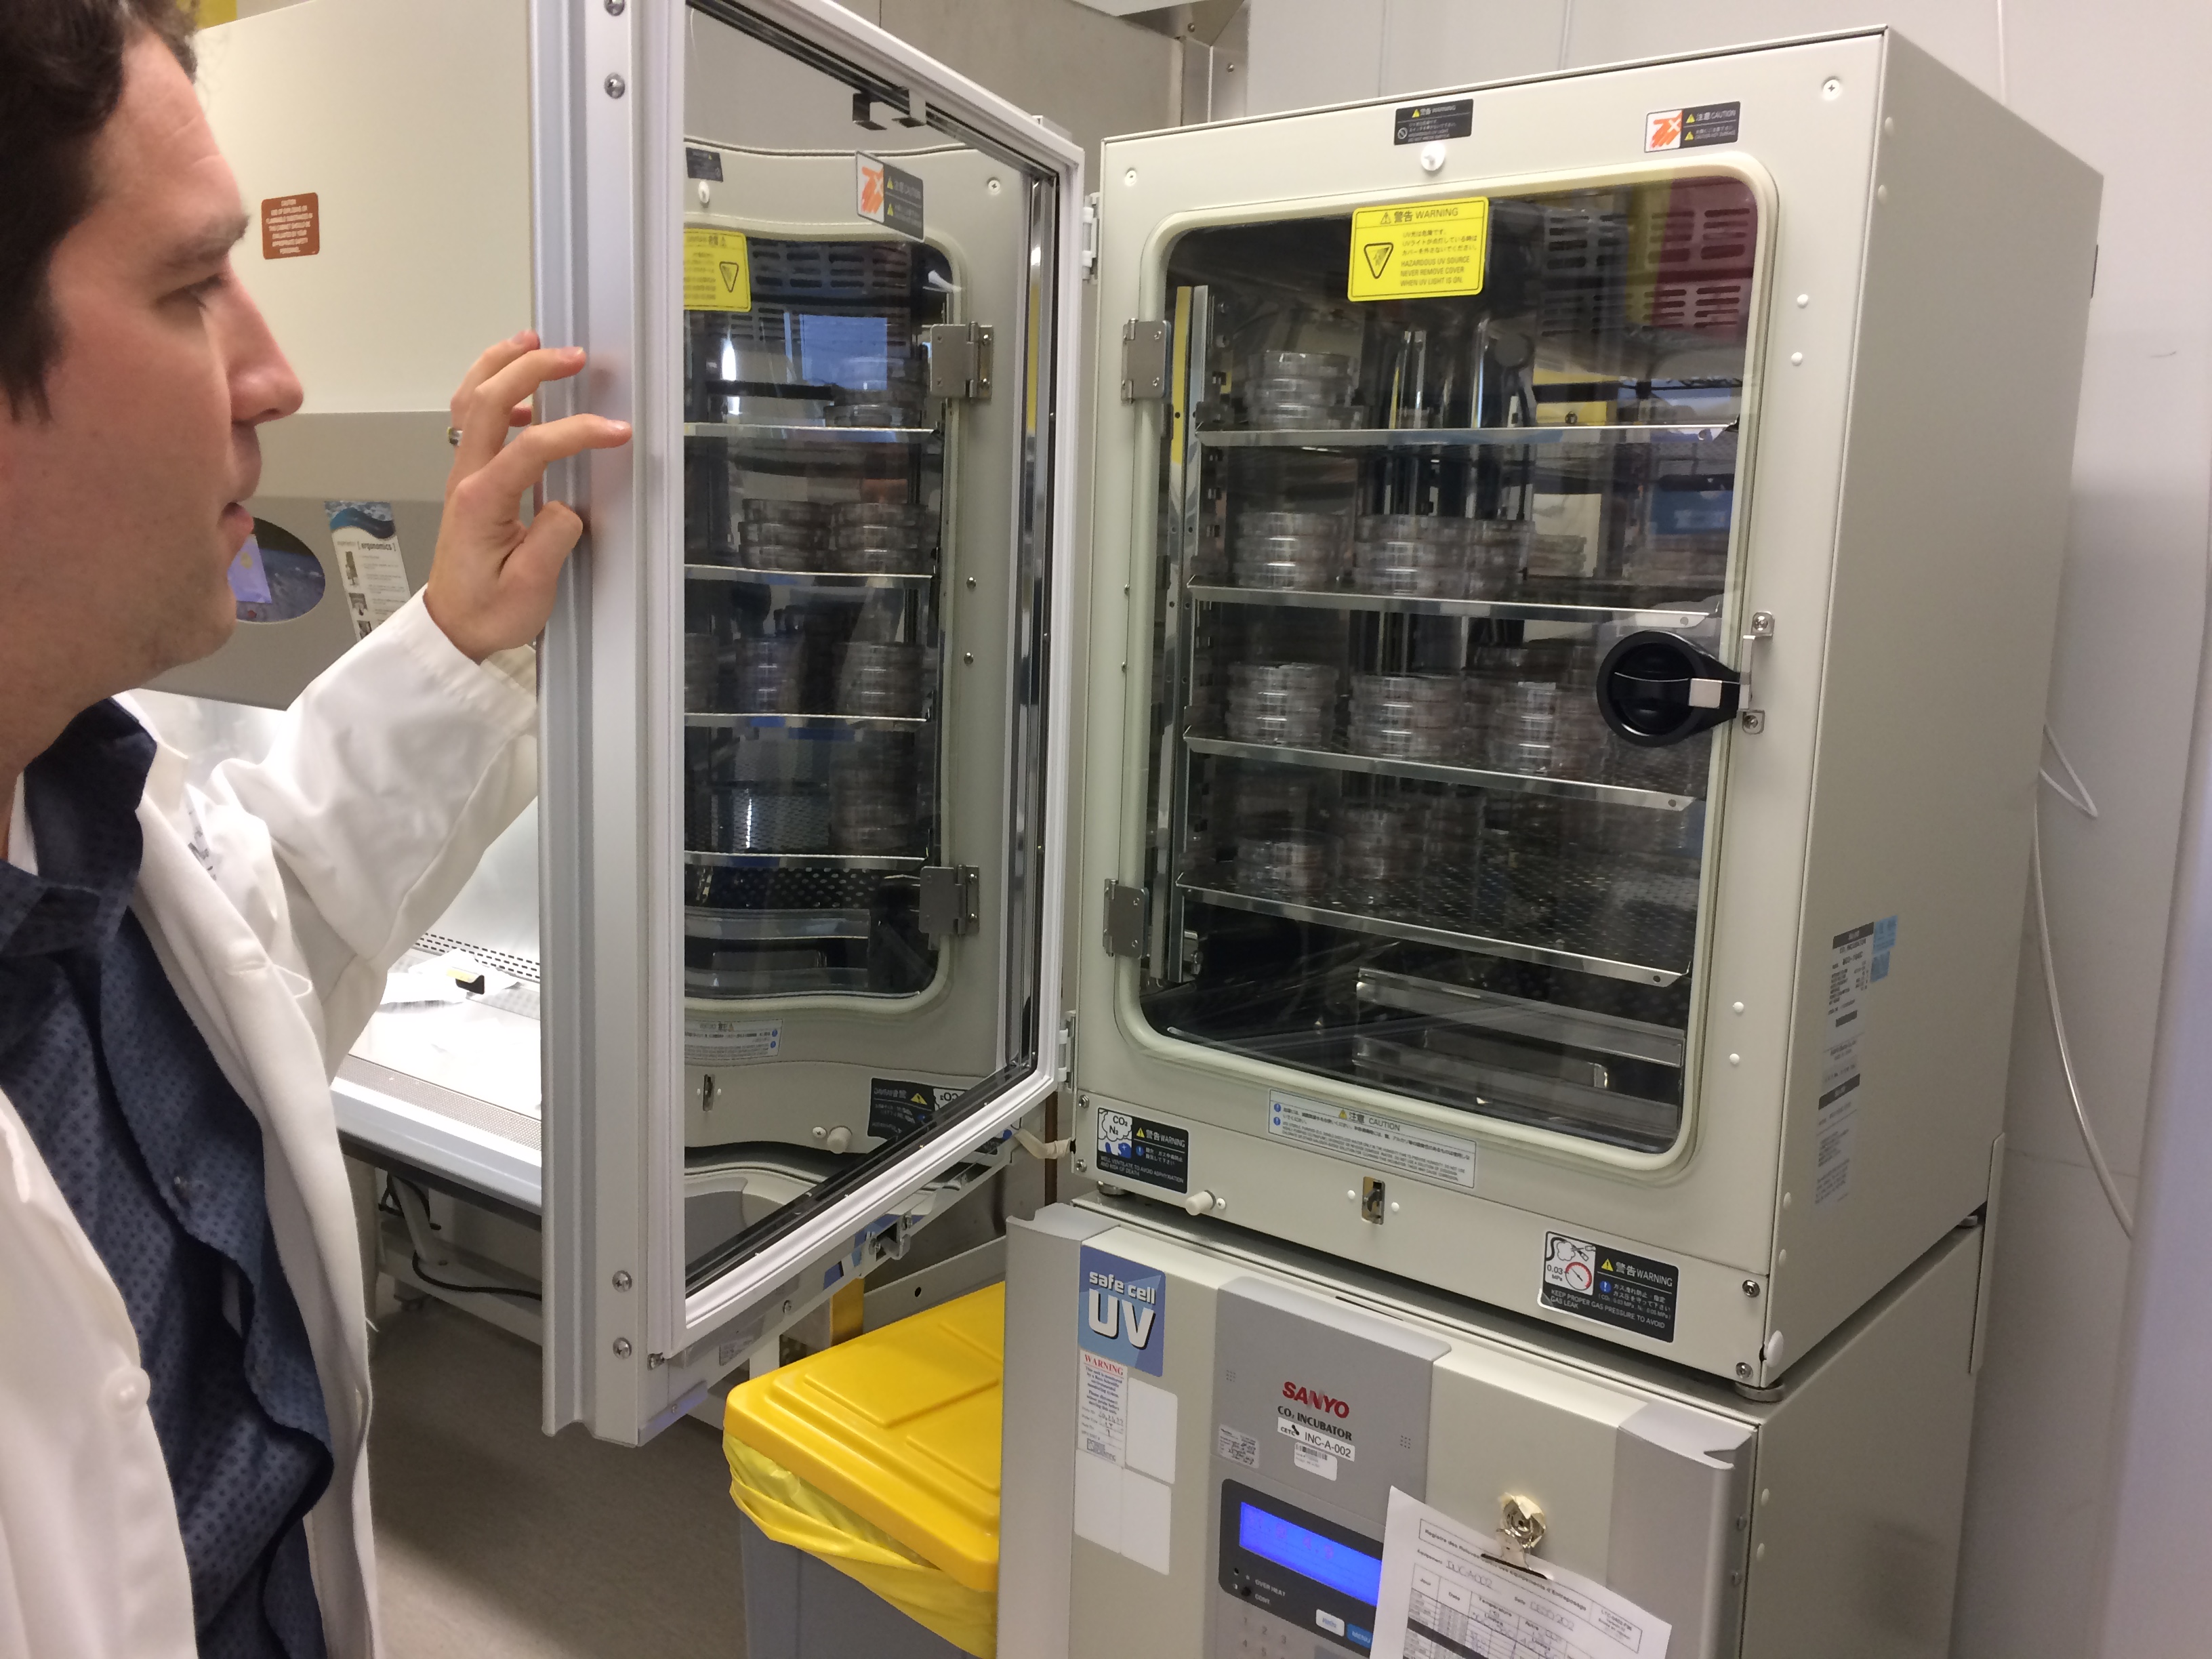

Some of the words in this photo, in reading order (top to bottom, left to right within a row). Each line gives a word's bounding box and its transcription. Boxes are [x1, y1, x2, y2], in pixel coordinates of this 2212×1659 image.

[1395, 211, 1412, 223] 警告
[1416, 207, 1458, 219] WARNING
[1401, 259, 1436, 267] HAZARDOUS
[1445, 266, 1465, 274] COVER
[1428, 276, 1445, 285] LIGHT
[1369, 1117, 1400, 1132] CAUTION
[1160, 1134, 1185, 1148] WARNING
[1547, 1265, 1563, 1275] 0.03
[1616, 1261, 1637, 1277] 警告
[1637, 1269, 1673, 1288] WARNING
[1089, 1271, 1125, 1295] safe
[1128, 1284, 1156, 1305] cell
[1551, 1296, 1563, 1305] GAS
[1564, 1300, 1579, 1309] LEAK
[1551, 1289, 1567, 1298] KEEP
[1567, 1293, 1590, 1307] PROPER
[1591, 1301, 1603, 1310] GAS
[1605, 1305, 1635, 1320] PRESSURE
[1645, 1317, 1666, 1328] AVOID
[1088, 1288, 1156, 1350] UV
[1084, 1354, 1124, 1376] WARNING
[1282, 1381, 1350, 1418] SANYO
[1297, 1412, 1353, 1441] INCUBATOR
[1281, 1427, 1296, 1437] CETC
[1305, 1431, 1351, 1458] INC-A-002
